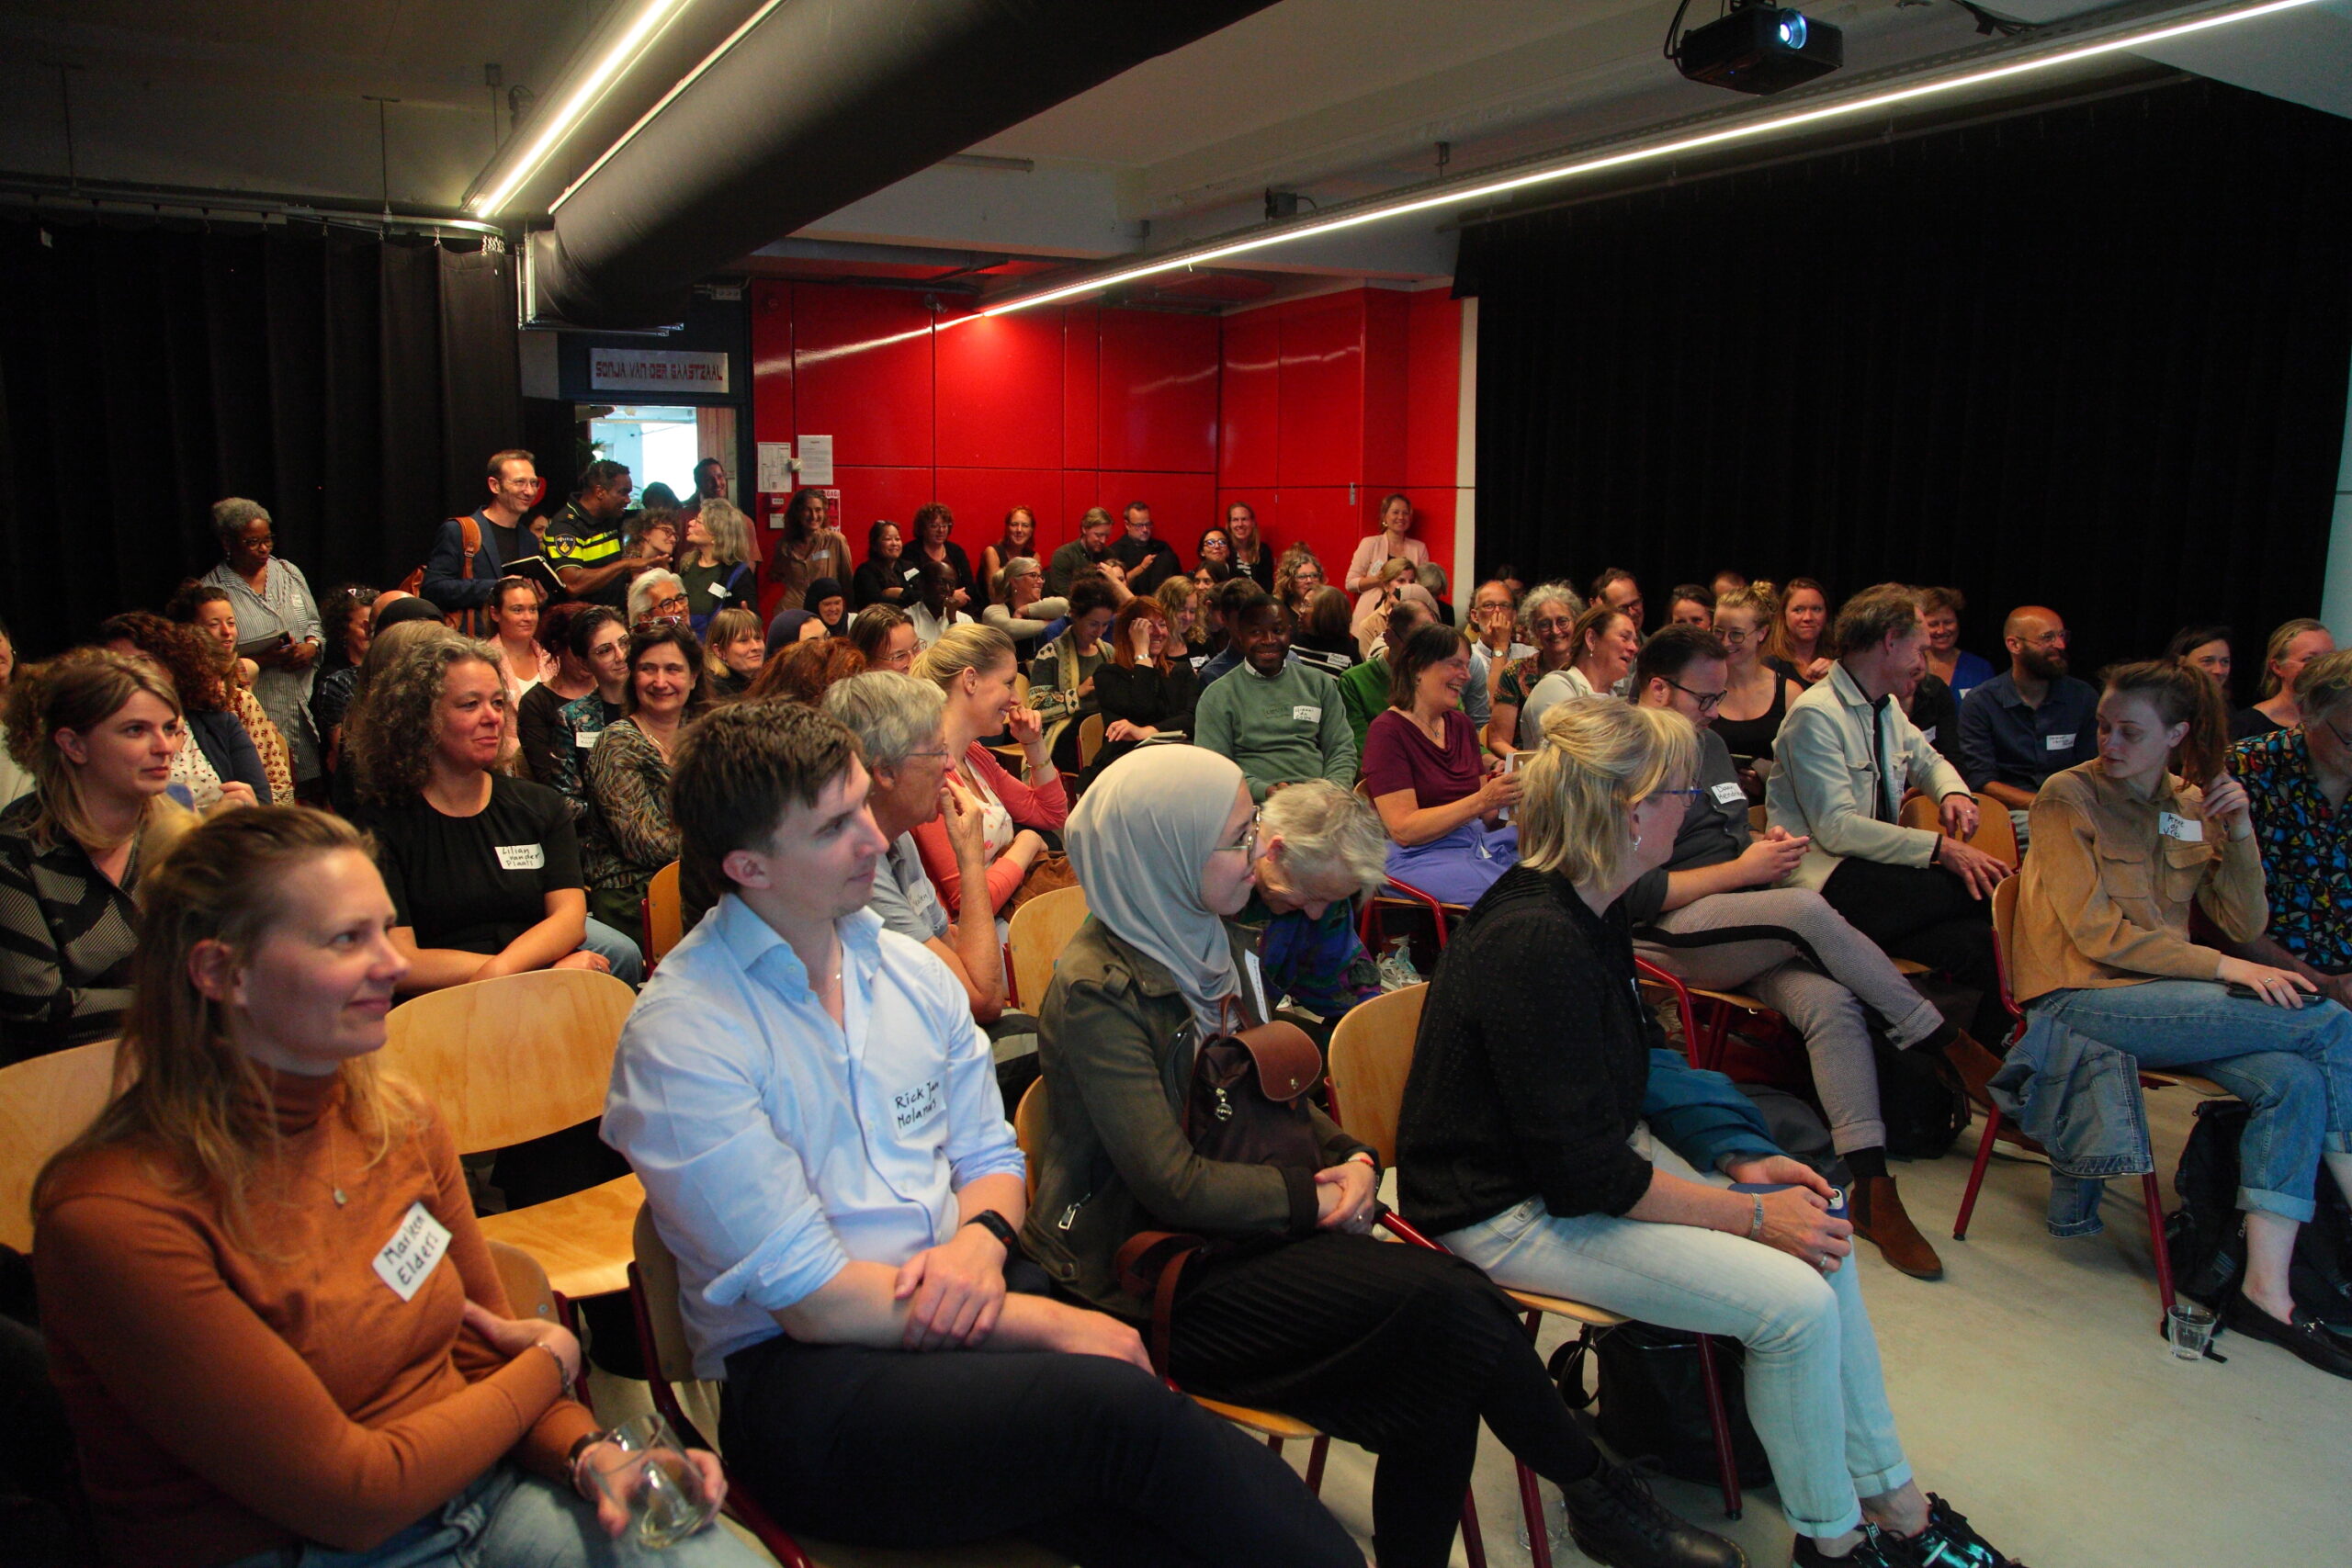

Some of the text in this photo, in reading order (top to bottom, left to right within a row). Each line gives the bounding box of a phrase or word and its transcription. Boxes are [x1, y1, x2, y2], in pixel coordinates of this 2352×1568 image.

[595, 361, 723, 381] SONJA VAN DER GAASTZAAL
[895, 1088, 924, 1109] Rick
